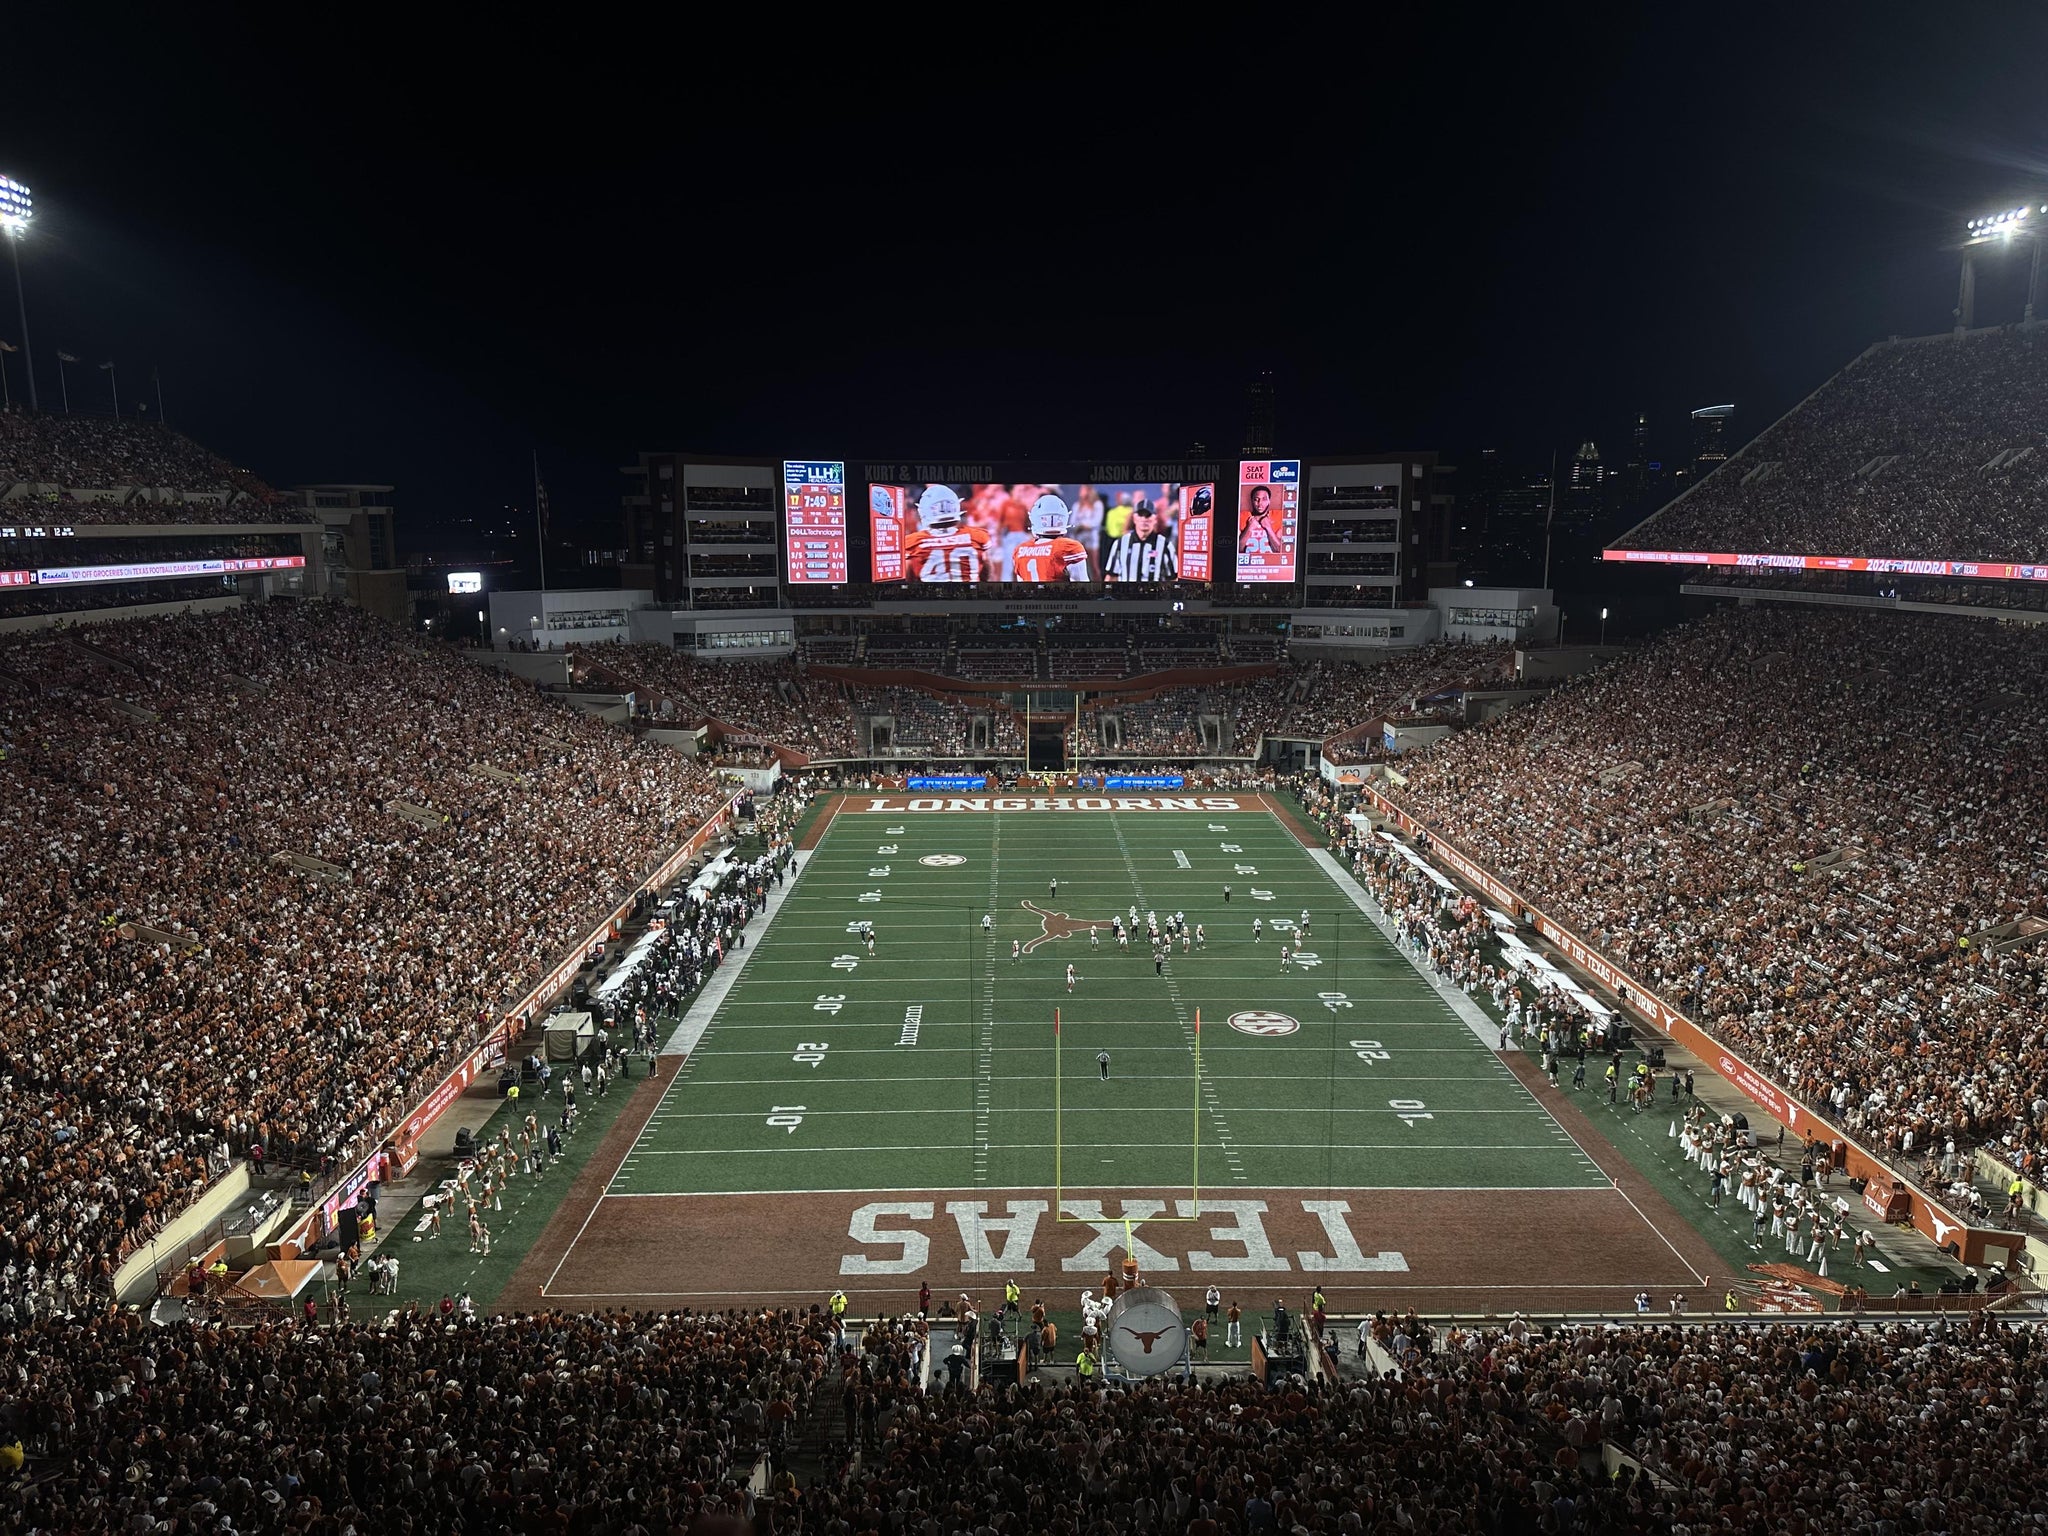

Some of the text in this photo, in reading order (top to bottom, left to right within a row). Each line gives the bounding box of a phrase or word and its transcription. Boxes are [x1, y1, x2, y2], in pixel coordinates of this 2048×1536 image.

[808, 467, 833, 479] LLH
[865, 465, 993, 481] KURT & TARA ARNOLD
[1090, 465, 1220, 481] JASON & KISHA ITKIN
[1246, 473, 1264, 481] GEEK
[1273, 469, 1296, 479] Corona
[790, 495, 800, 506] 17
[804, 495, 827, 508] 7:49
[832, 495, 840, 506] 3
[1017, 545, 1053, 558] SIMMONS
[1238, 555, 1250, 565] 28
[1736, 555, 1758, 567] 2026
[1769, 556, 1807, 569] TUNDRA
[1866, 559, 1890, 572] 2026
[1902, 561, 1946, 575] TUNDRA
[81, 569, 93, 579] OFF
[94, 567, 123, 578] GROCERIES
[132, 565, 149, 576] TEXAS
[149, 564, 174, 575] FOOTBALL
[1026, 558, 1040, 582] 1
[1963, 565, 1979, 575] TEXAS
[865, 798, 1241, 812] LONGHORNS
[1490, 881, 1512, 909] STADIUM
[1269, 919, 1299, 931] 50
[1292, 952, 1323, 966] 40
[1543, 921, 1562, 947] HOME
[1561, 936, 1571, 952] OF
[1571, 942, 1587, 966] THE
[1586, 954, 1611, 983] TEXAS
[831, 954, 860, 968] 40
[813, 994, 846, 1010] 30
[1317, 992, 1354, 1009] 30
[894, 1005, 923, 1046] humann
[792, 1043, 830, 1062] 20
[1349, 1040, 1392, 1060] 20
[1736, 1074, 1782, 1113] PROVIDER FOR BEVO
[1743, 1071, 1775, 1100] PROUD TRUCK
[427, 1082, 453, 1112] PROUD TRUCK
[422, 1086, 459, 1125] PROVIDER FOR BEVO
[1388, 1099, 1435, 1120] 10
[766, 1105, 807, 1126] 10
[1864, 1194, 1886, 1217] TEXAS
[840, 1199, 1410, 1273] TEXAS
